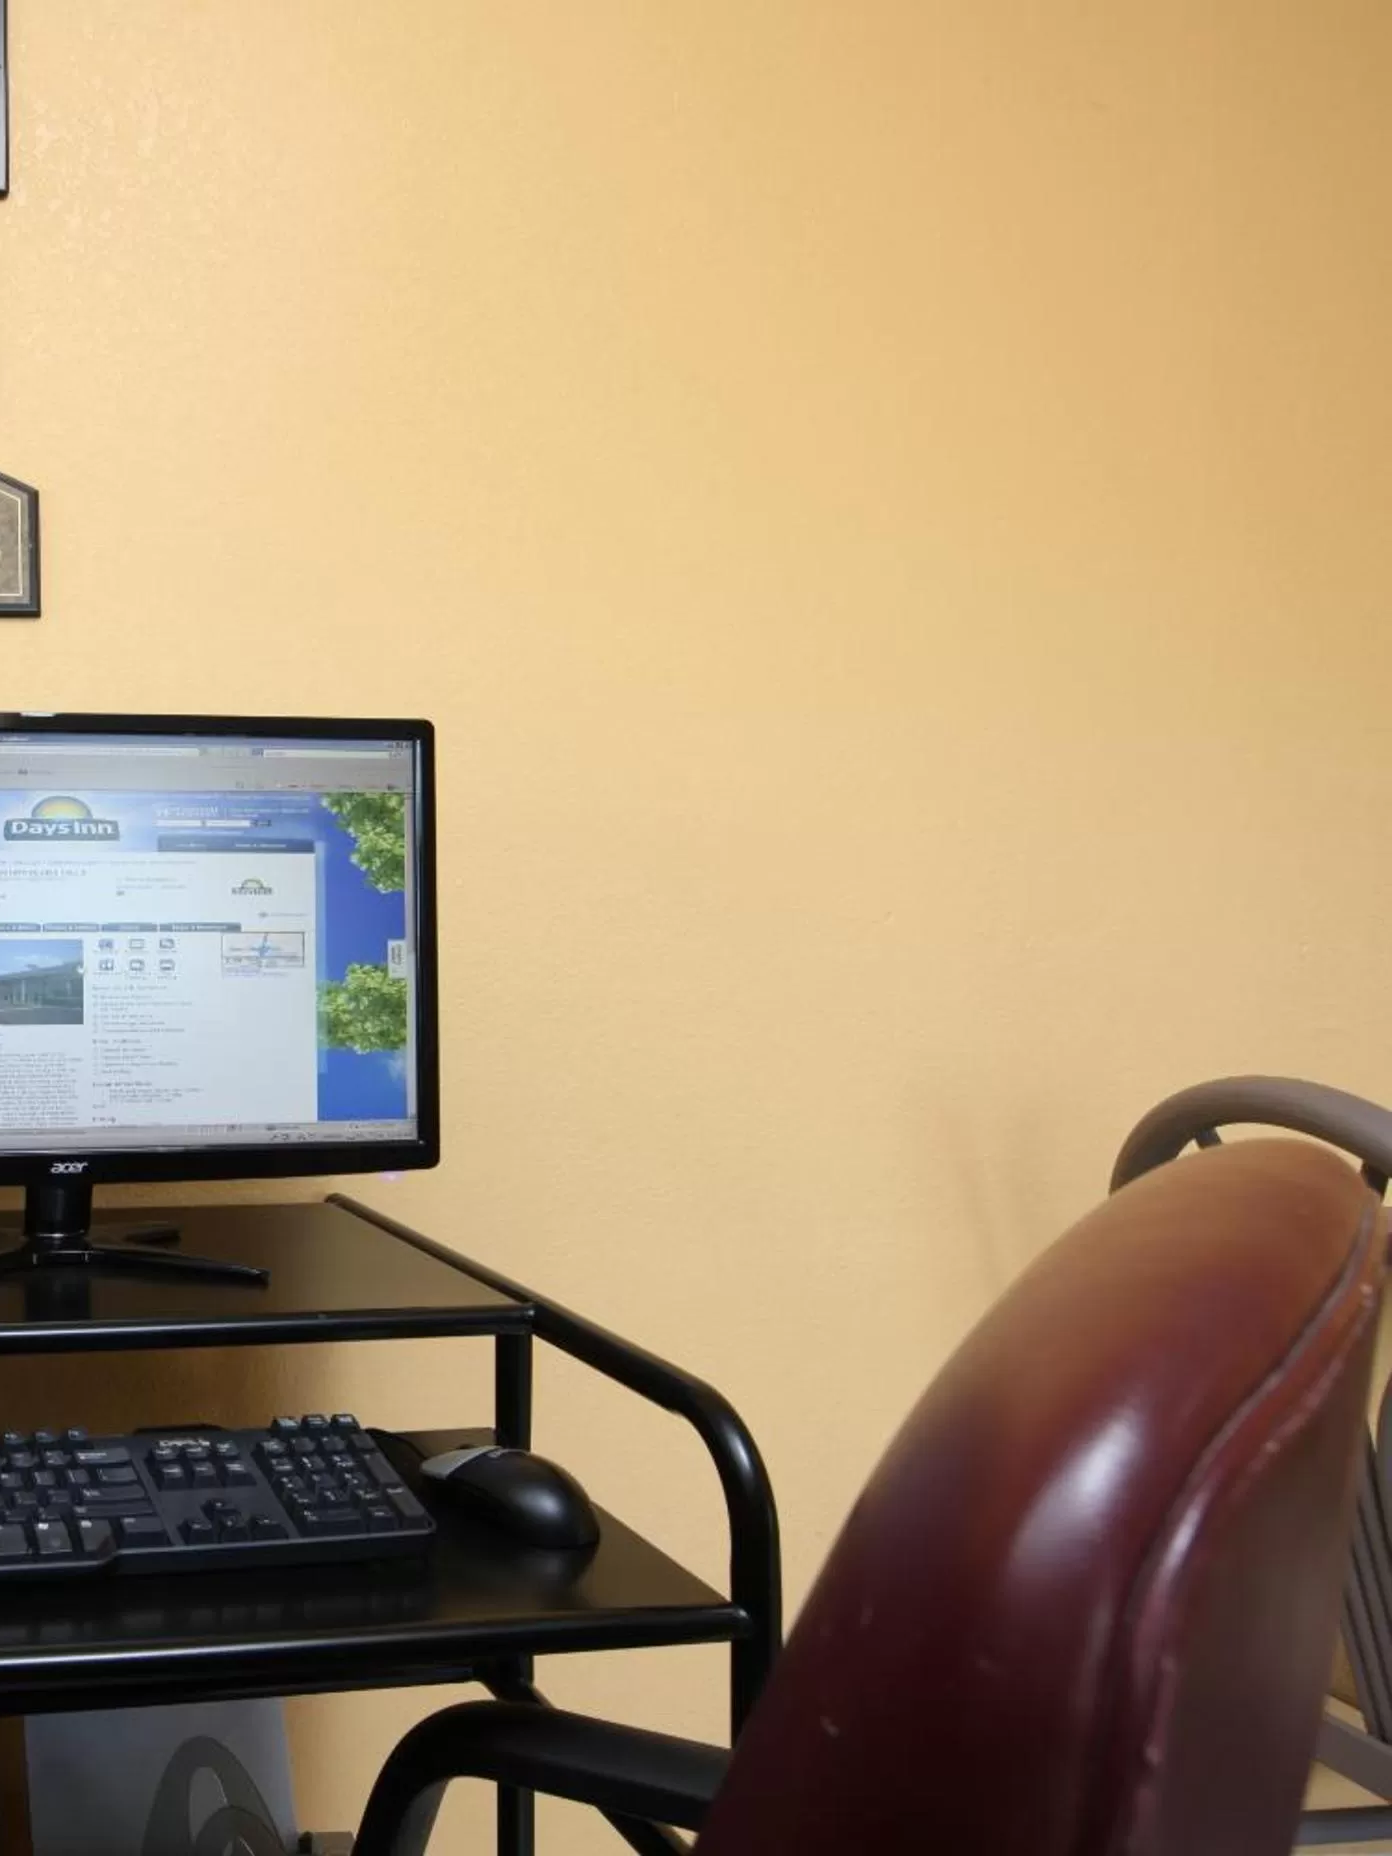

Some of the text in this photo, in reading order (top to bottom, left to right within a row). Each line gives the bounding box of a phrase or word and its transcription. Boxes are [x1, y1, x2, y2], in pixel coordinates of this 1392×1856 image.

[11, 819, 115, 837] Days Inn
[50, 1161, 89, 1174] acer
